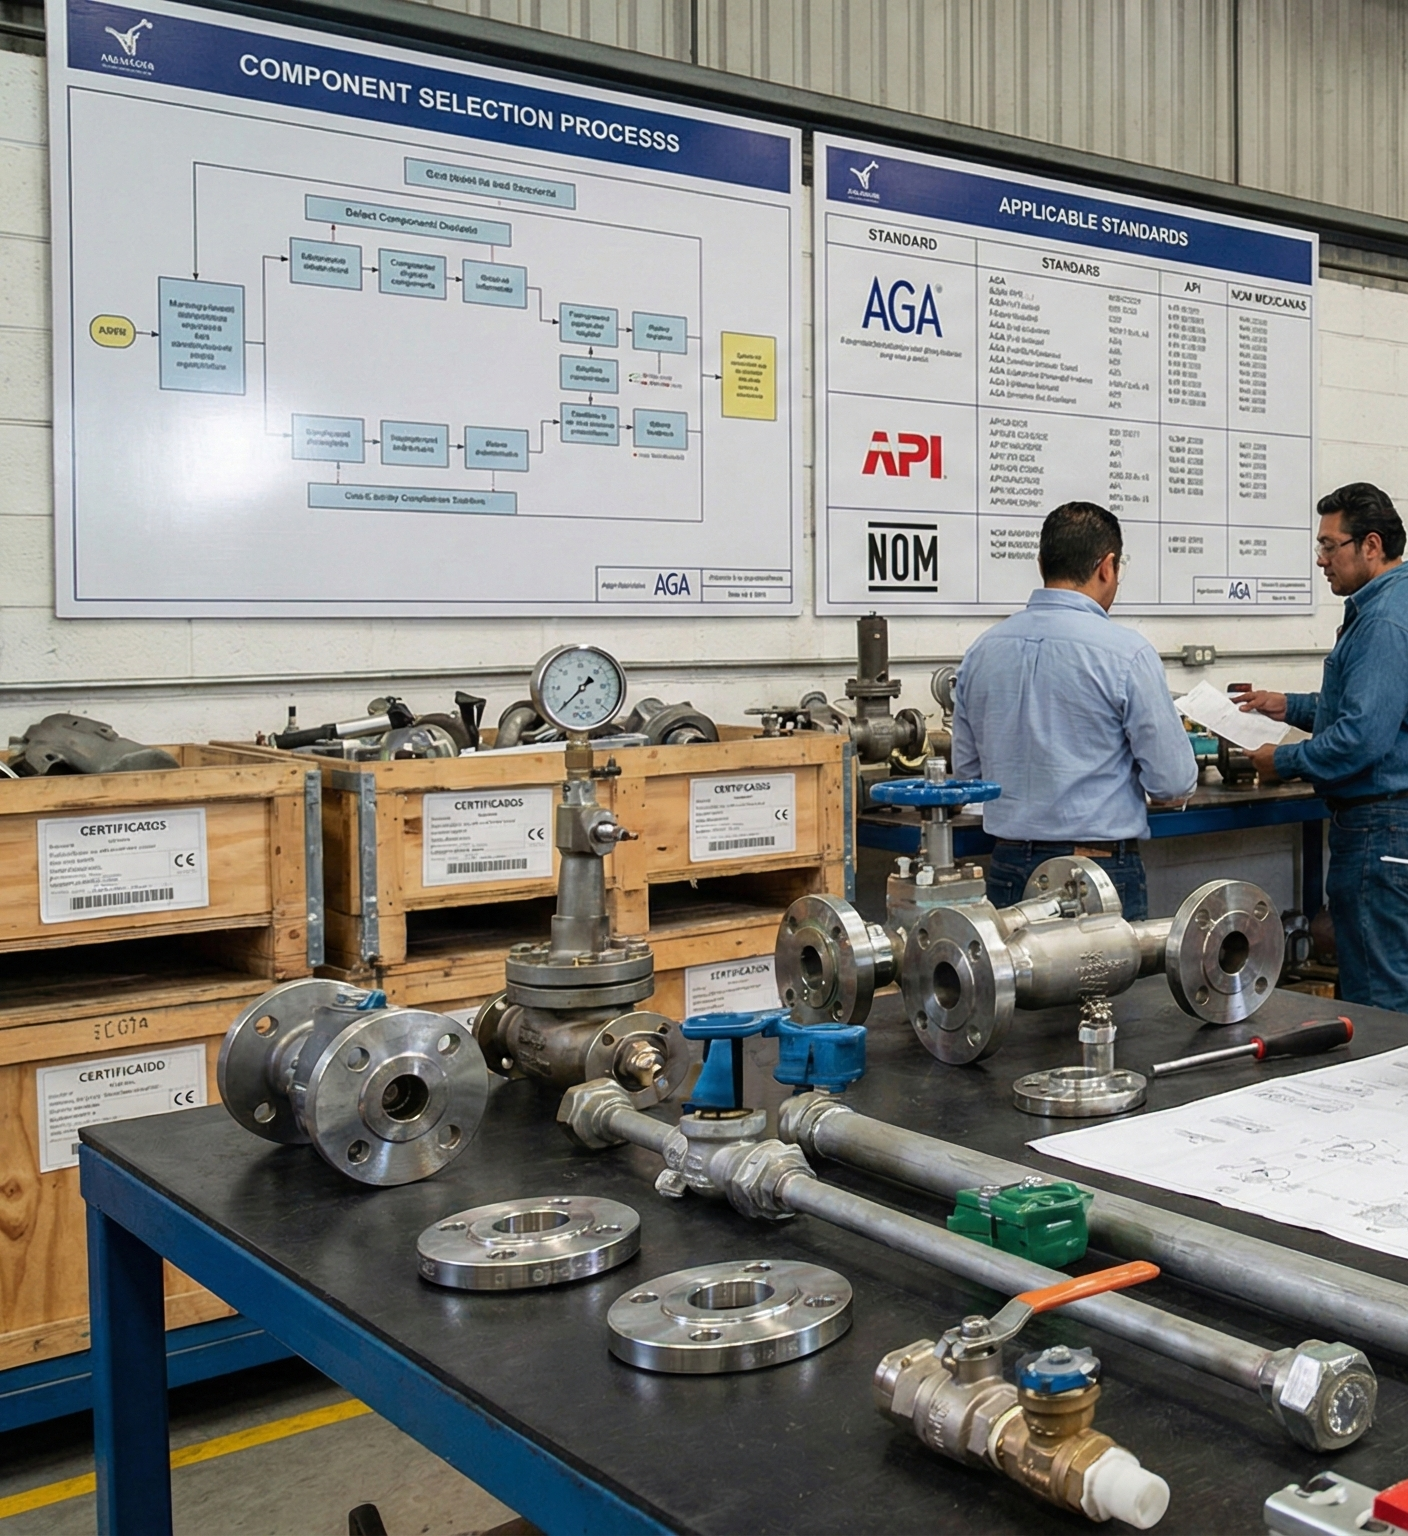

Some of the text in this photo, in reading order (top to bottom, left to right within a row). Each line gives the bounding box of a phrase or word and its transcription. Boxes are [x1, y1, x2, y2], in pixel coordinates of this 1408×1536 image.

[239, 54, 680, 153] COMPONENT SELECTION PROCESSS
[998, 197, 1189, 247] APPLICABLE STANDARDS
[868, 228, 938, 250] STANDARD
[1042, 257, 1100, 277] STANDARS
[862, 275, 943, 338] AGA
[862, 431, 942, 479] API
[868, 533, 938, 581] NOM
[654, 573, 690, 595] AGA
[1228, 581, 1251, 599] AGA
[454, 798, 524, 810] CERTIFICADOS
[528, 827, 545, 841] CE
[174, 852, 195, 868] CE
[174, 1090, 195, 1106] CE
